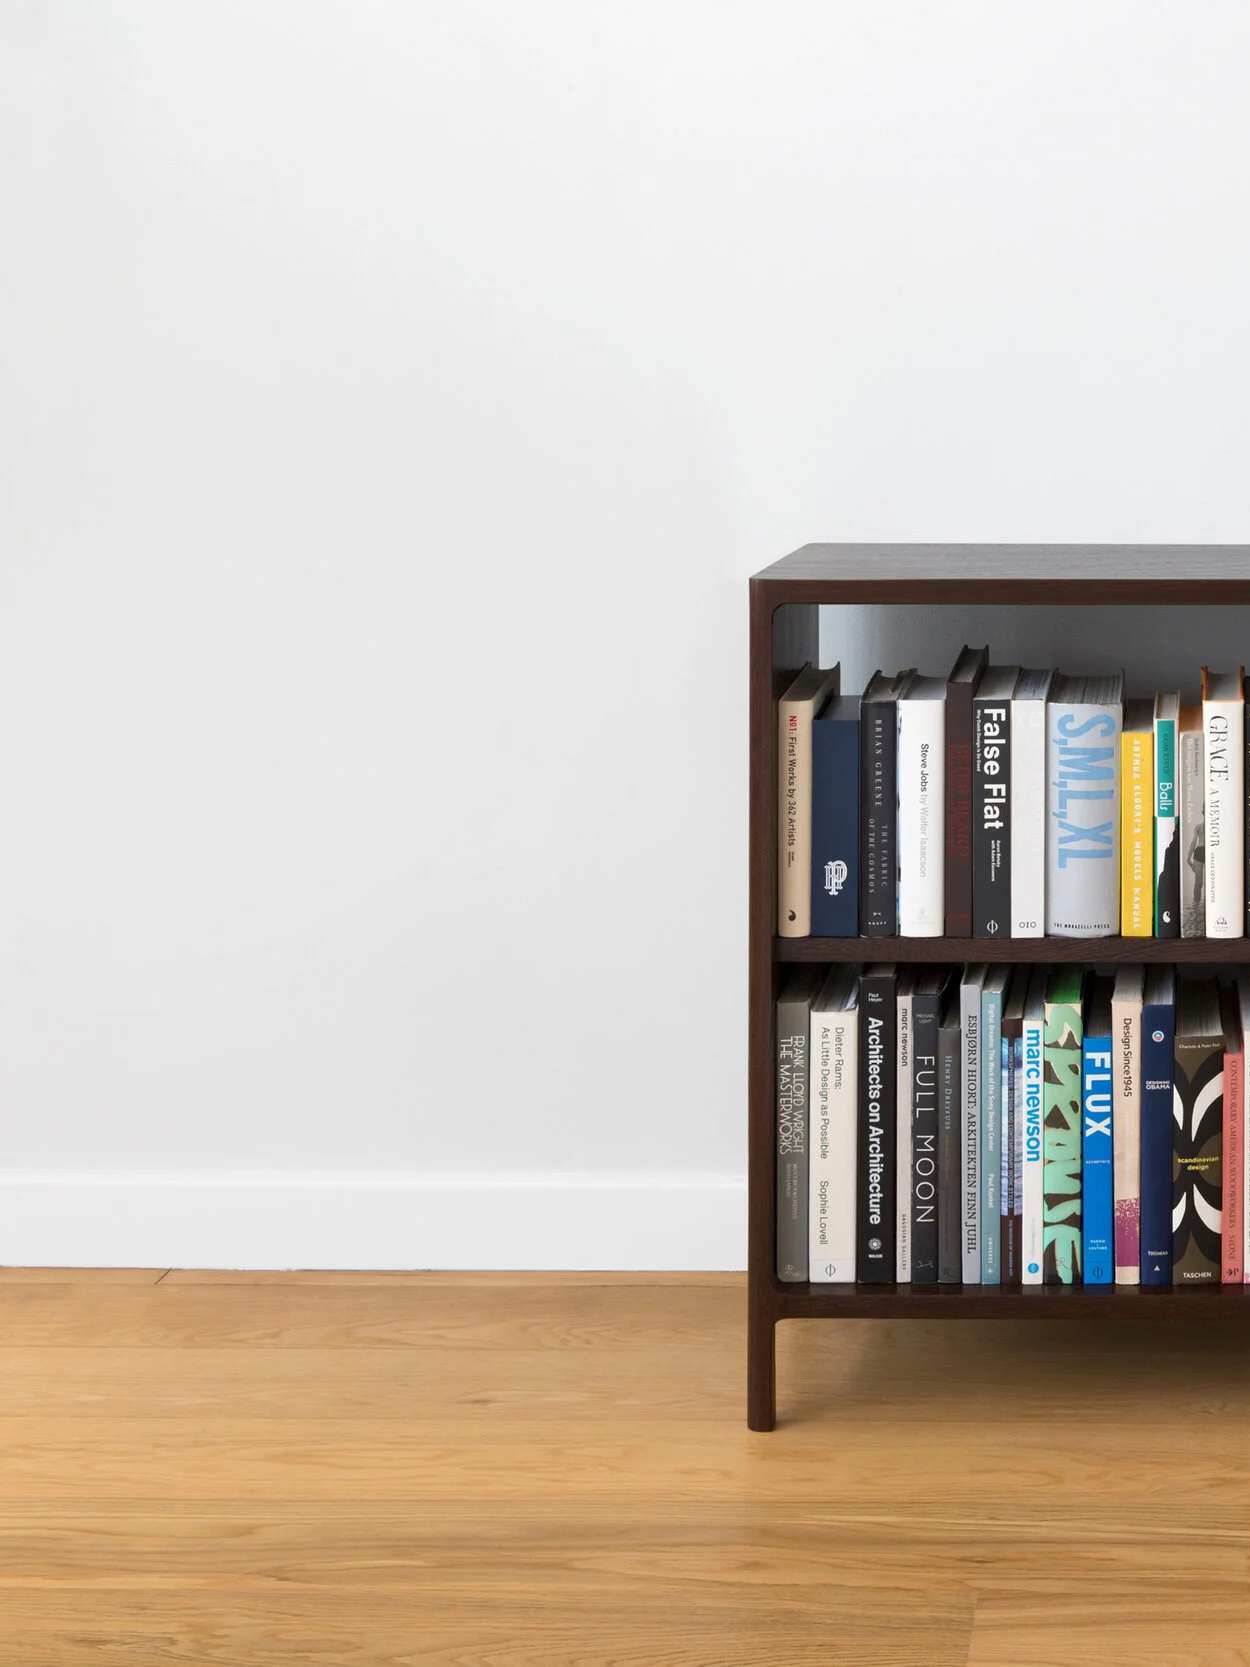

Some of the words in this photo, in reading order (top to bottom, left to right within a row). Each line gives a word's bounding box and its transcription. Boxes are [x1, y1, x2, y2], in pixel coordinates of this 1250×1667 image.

[788, 736, 796, 757] First
[920, 744, 929, 768] Steve
[984, 709, 1006, 775] False
[1209, 716, 1229, 782] GRACE
[788, 760, 796, 786] Works
[1133, 740, 1141, 779] ARTHUR
[786, 789, 796, 798] by
[920, 770, 929, 792] Jobs
[1052, 714, 1116, 868] S,M,L,XL
[1159, 782, 1172, 810] Balls
[1210, 788, 1219, 796] A
[788, 801, 796, 815] 362
[919, 795, 928, 805] by
[984, 784, 1006, 829] Flat
[1134, 786, 1142, 833] ELGORT'S
[788, 818, 796, 846] Artists
[869, 819, 875, 830] OF
[920, 807, 928, 835] Walter
[1210, 800, 1220, 847] MEMOIR
[919, 838, 928, 877] Isaacson
[1133, 888, 1141, 928] MANUAL
[987, 1004, 995, 1022] Digital
[780, 1036, 792, 1059] THE
[821, 1028, 830, 1039] As
[835, 1027, 844, 1056] Dieter
[966, 1015, 977, 1066] ESBJØRN
[1122, 1018, 1132, 1050] Design
[793, 1036, 804, 1068] FRANK
[821, 1041, 830, 1066] Little
[868, 1018, 883, 1099] Architects
[1027, 1029, 1040, 1078] marc
[793, 1073, 804, 1107] LLOYD
[819, 1069, 829, 1102] Design
[835, 1060, 844, 1090] Rams:
[916, 1056, 935, 1118] FULL
[967, 1070, 976, 1109] HIORT:
[987, 1096, 995, 1110] Sony
[1085, 1051, 1110, 1137] FLUX
[1229, 1061, 1238, 1123] CONTEMPORARY
[779, 1065, 791, 1155] MASTERWORKS
[820, 1105, 827, 1115] as
[869, 1102, 880, 1122] on
[987, 1112, 995, 1131] Design
[1027, 1084, 1040, 1162] newson
[793, 1111, 804, 1154] WRIGHT
[820, 1119, 829, 1159] Possible
[1229, 1125, 1237, 1166] AMERICAN
[967, 1113, 976, 1188] ARKITEKTEN
[869, 1126, 884, 1224] Architecture
[916, 1135, 935, 1223] MOON
[818, 1181, 829, 1214] Sophie
[967, 1192, 976, 1219] FINN
[1228, 1167, 1237, 1228] WOODWORKERS
[819, 1217, 829, 1245] Lovell
[965, 1222, 976, 1254] JUHL
[1228, 1235, 1237, 1261] STONE
